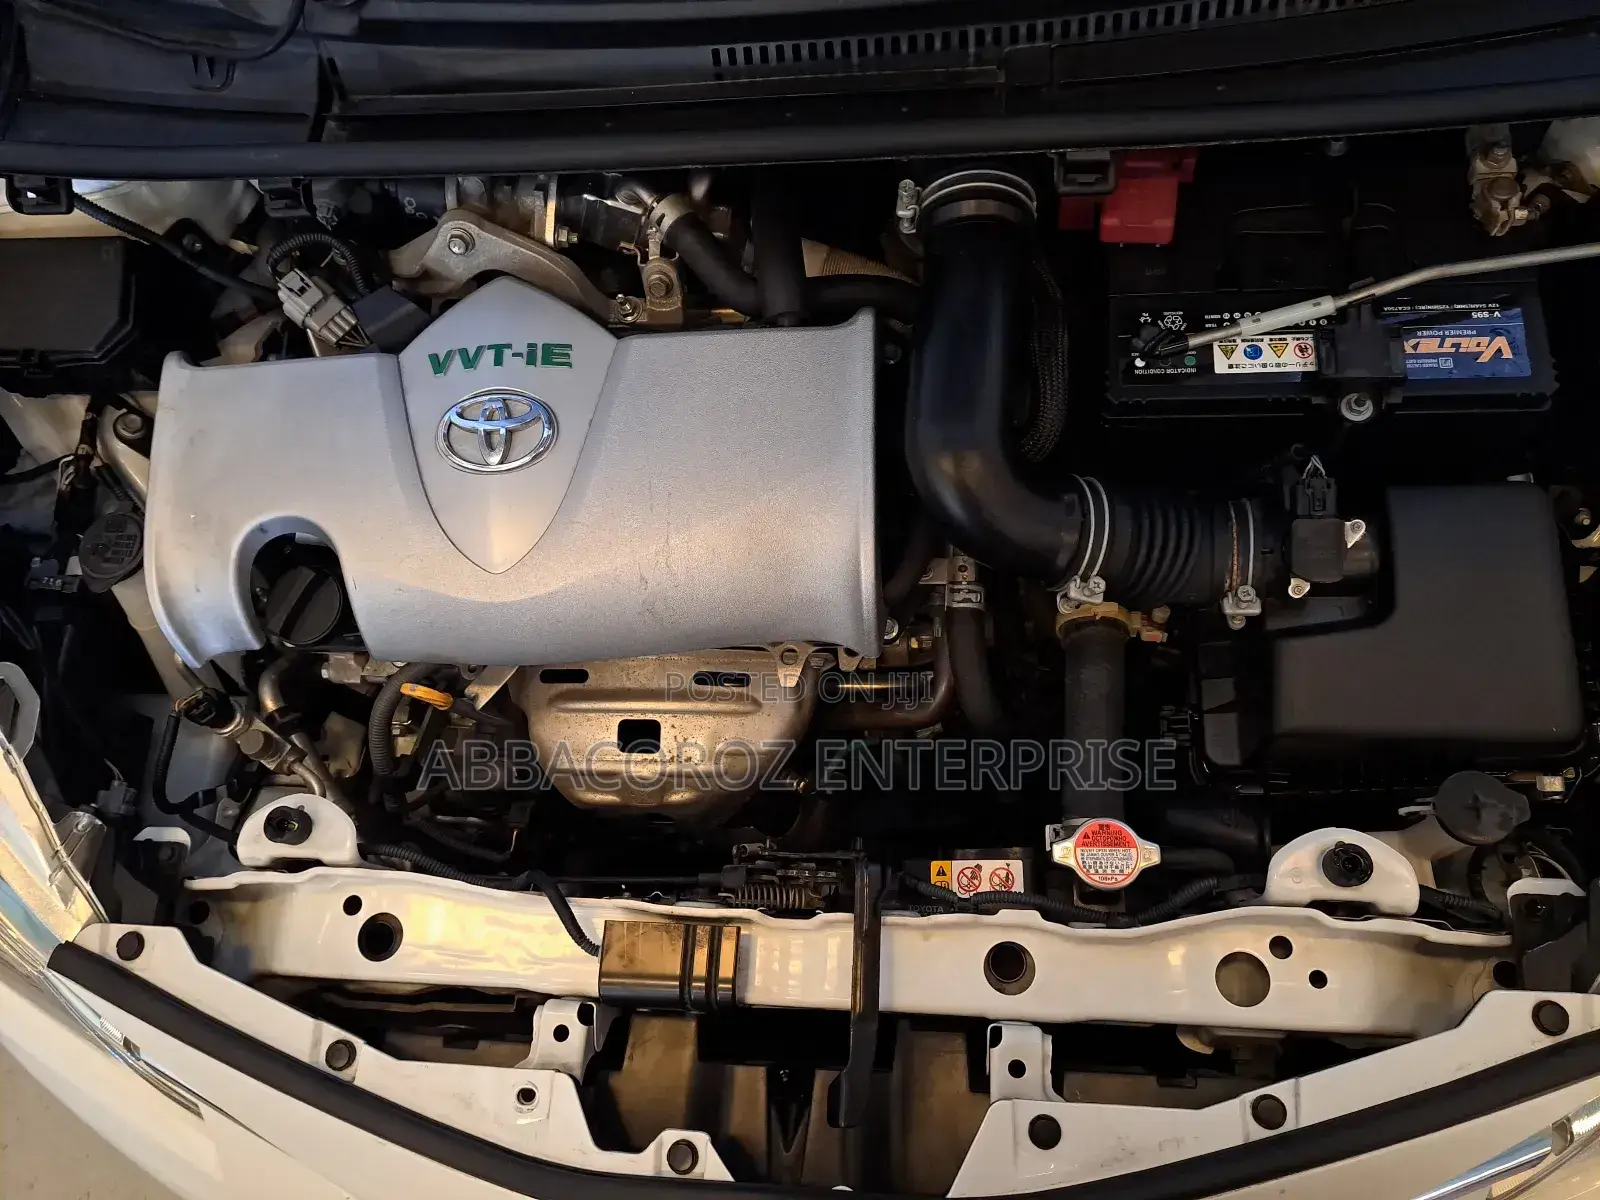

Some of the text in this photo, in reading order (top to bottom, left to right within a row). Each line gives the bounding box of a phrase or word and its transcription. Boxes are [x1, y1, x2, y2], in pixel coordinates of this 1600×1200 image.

[428, 342, 573, 376] VVT-iE
[1228, 362, 1314, 370] ッテリーの取り扱いにご注意
[908, 904, 944, 913] TOYOTA
